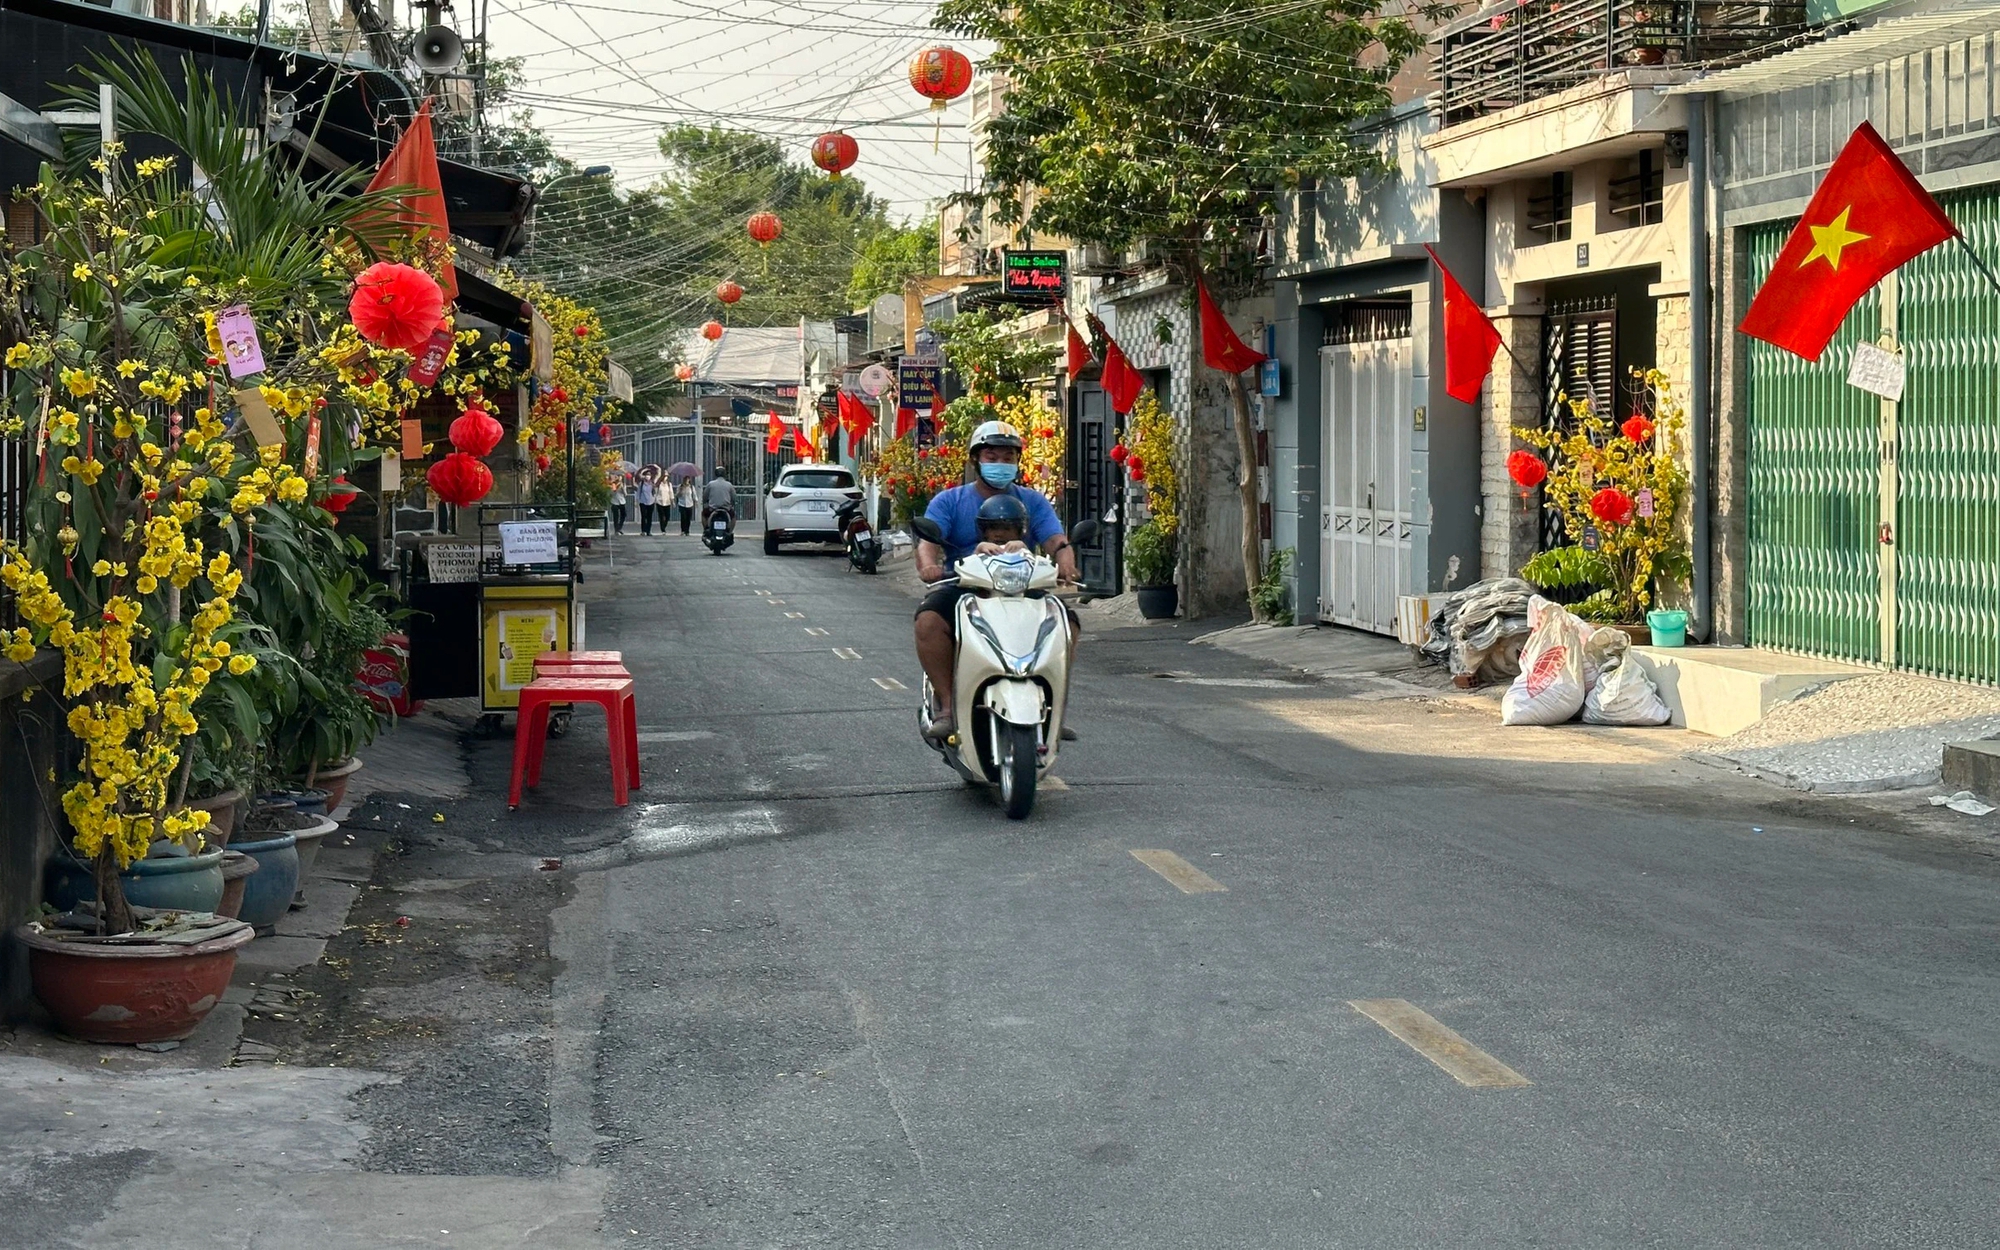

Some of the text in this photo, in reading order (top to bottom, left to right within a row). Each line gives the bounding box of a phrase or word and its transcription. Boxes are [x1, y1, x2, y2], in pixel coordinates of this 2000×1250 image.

[1579, 245, 1587, 258] 60
[1009, 256, 1060, 266] Hair Salon
